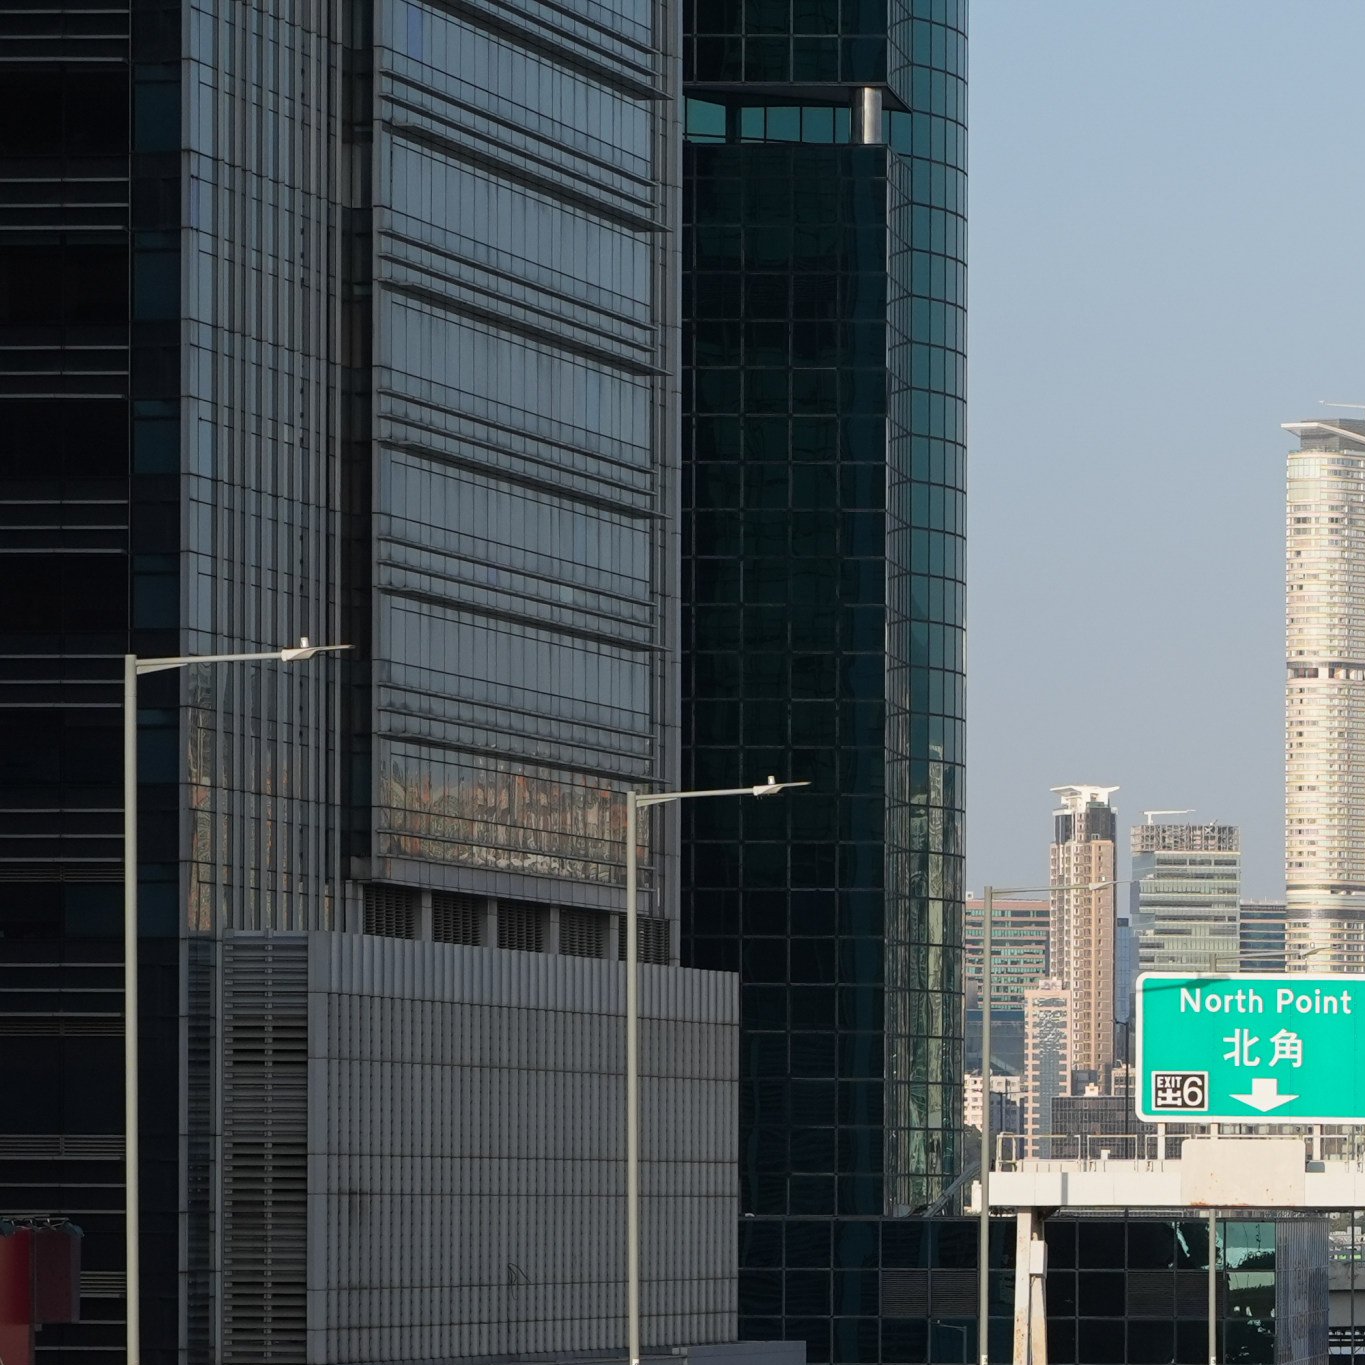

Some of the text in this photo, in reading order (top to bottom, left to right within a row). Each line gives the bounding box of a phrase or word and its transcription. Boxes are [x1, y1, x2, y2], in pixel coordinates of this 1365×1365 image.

[1180, 987, 1352, 1014] North Point
[1222, 1028, 1303, 1068] 北角
[1157, 1076, 1182, 1088] EXIT
[1182, 1076, 1203, 1106] 6
[1157, 1088, 1182, 1106] 出
